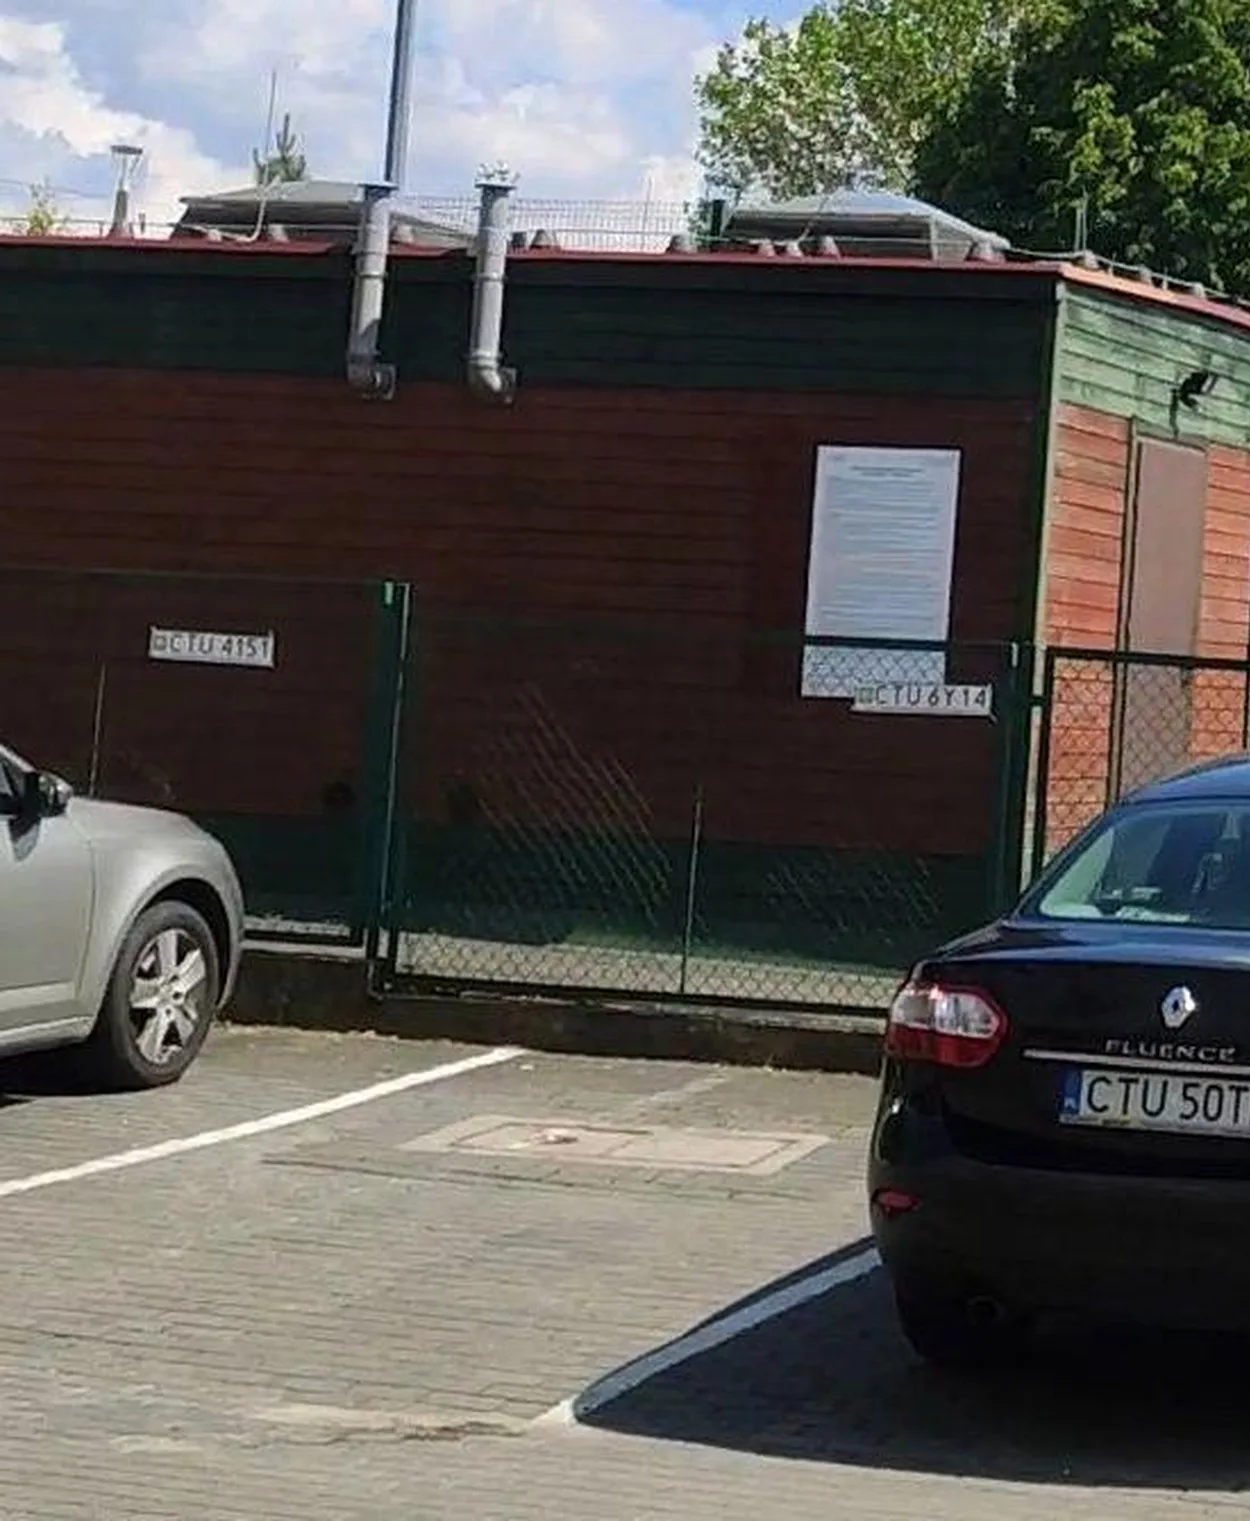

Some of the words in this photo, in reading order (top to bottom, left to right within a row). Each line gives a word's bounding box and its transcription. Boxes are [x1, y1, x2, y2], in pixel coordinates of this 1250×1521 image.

[170, 633, 215, 654] CTU
[875, 683, 921, 706] CTU
[928, 687, 987, 710] 6Y14
[1105, 1039, 1236, 1063] FLUENCE
[1087, 1075, 1170, 1118] CTU
